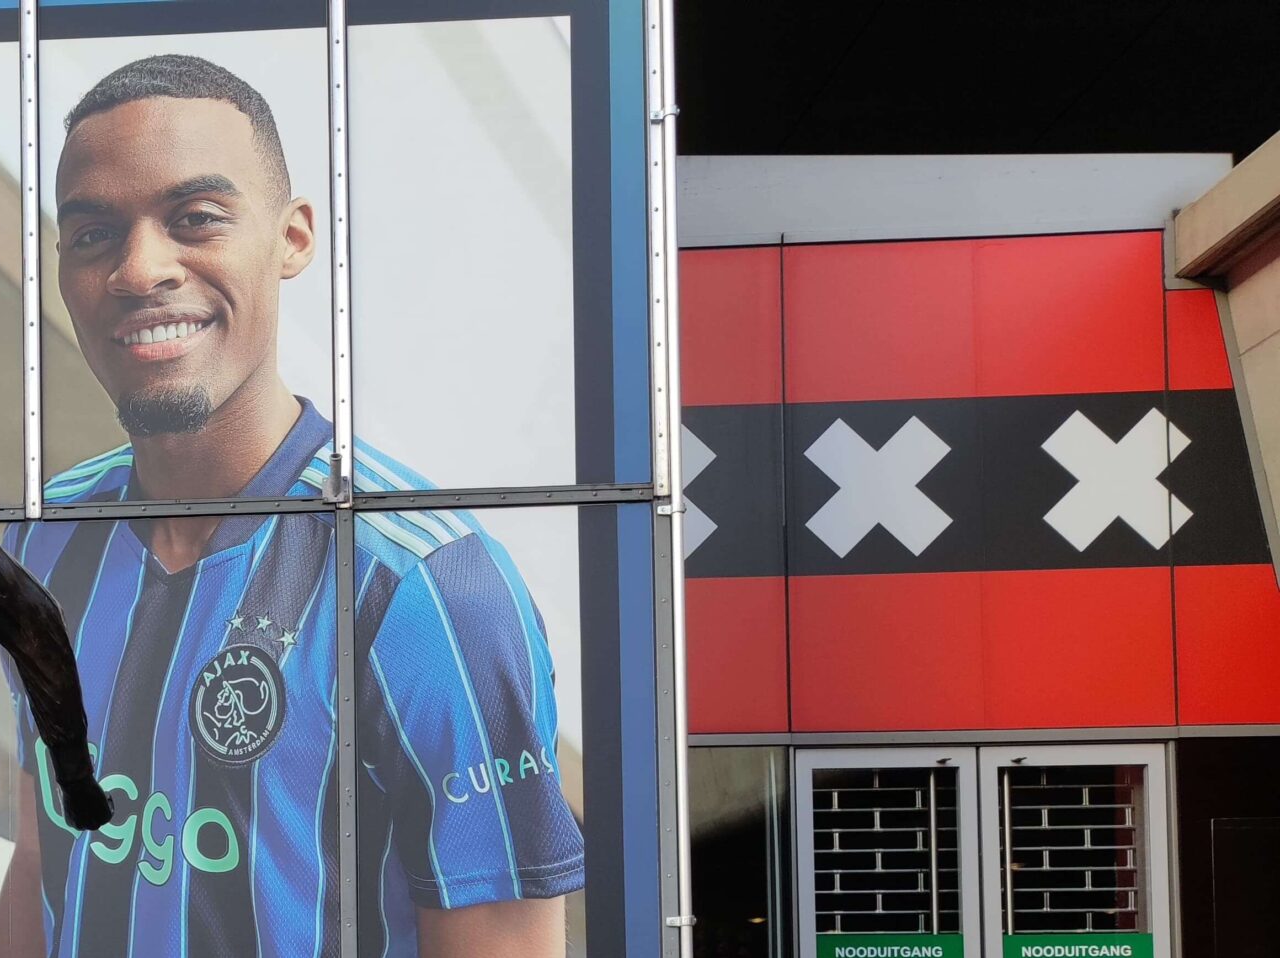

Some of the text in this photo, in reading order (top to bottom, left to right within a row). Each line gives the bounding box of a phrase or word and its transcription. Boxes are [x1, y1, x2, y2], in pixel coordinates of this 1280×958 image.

[202, 650, 250, 687] AJAX
[228, 729, 270, 756] AMSTERDAM
[835, 946, 943, 958] NOODUITGANG
[1021, 945, 1132, 957] NOODUITGANG
